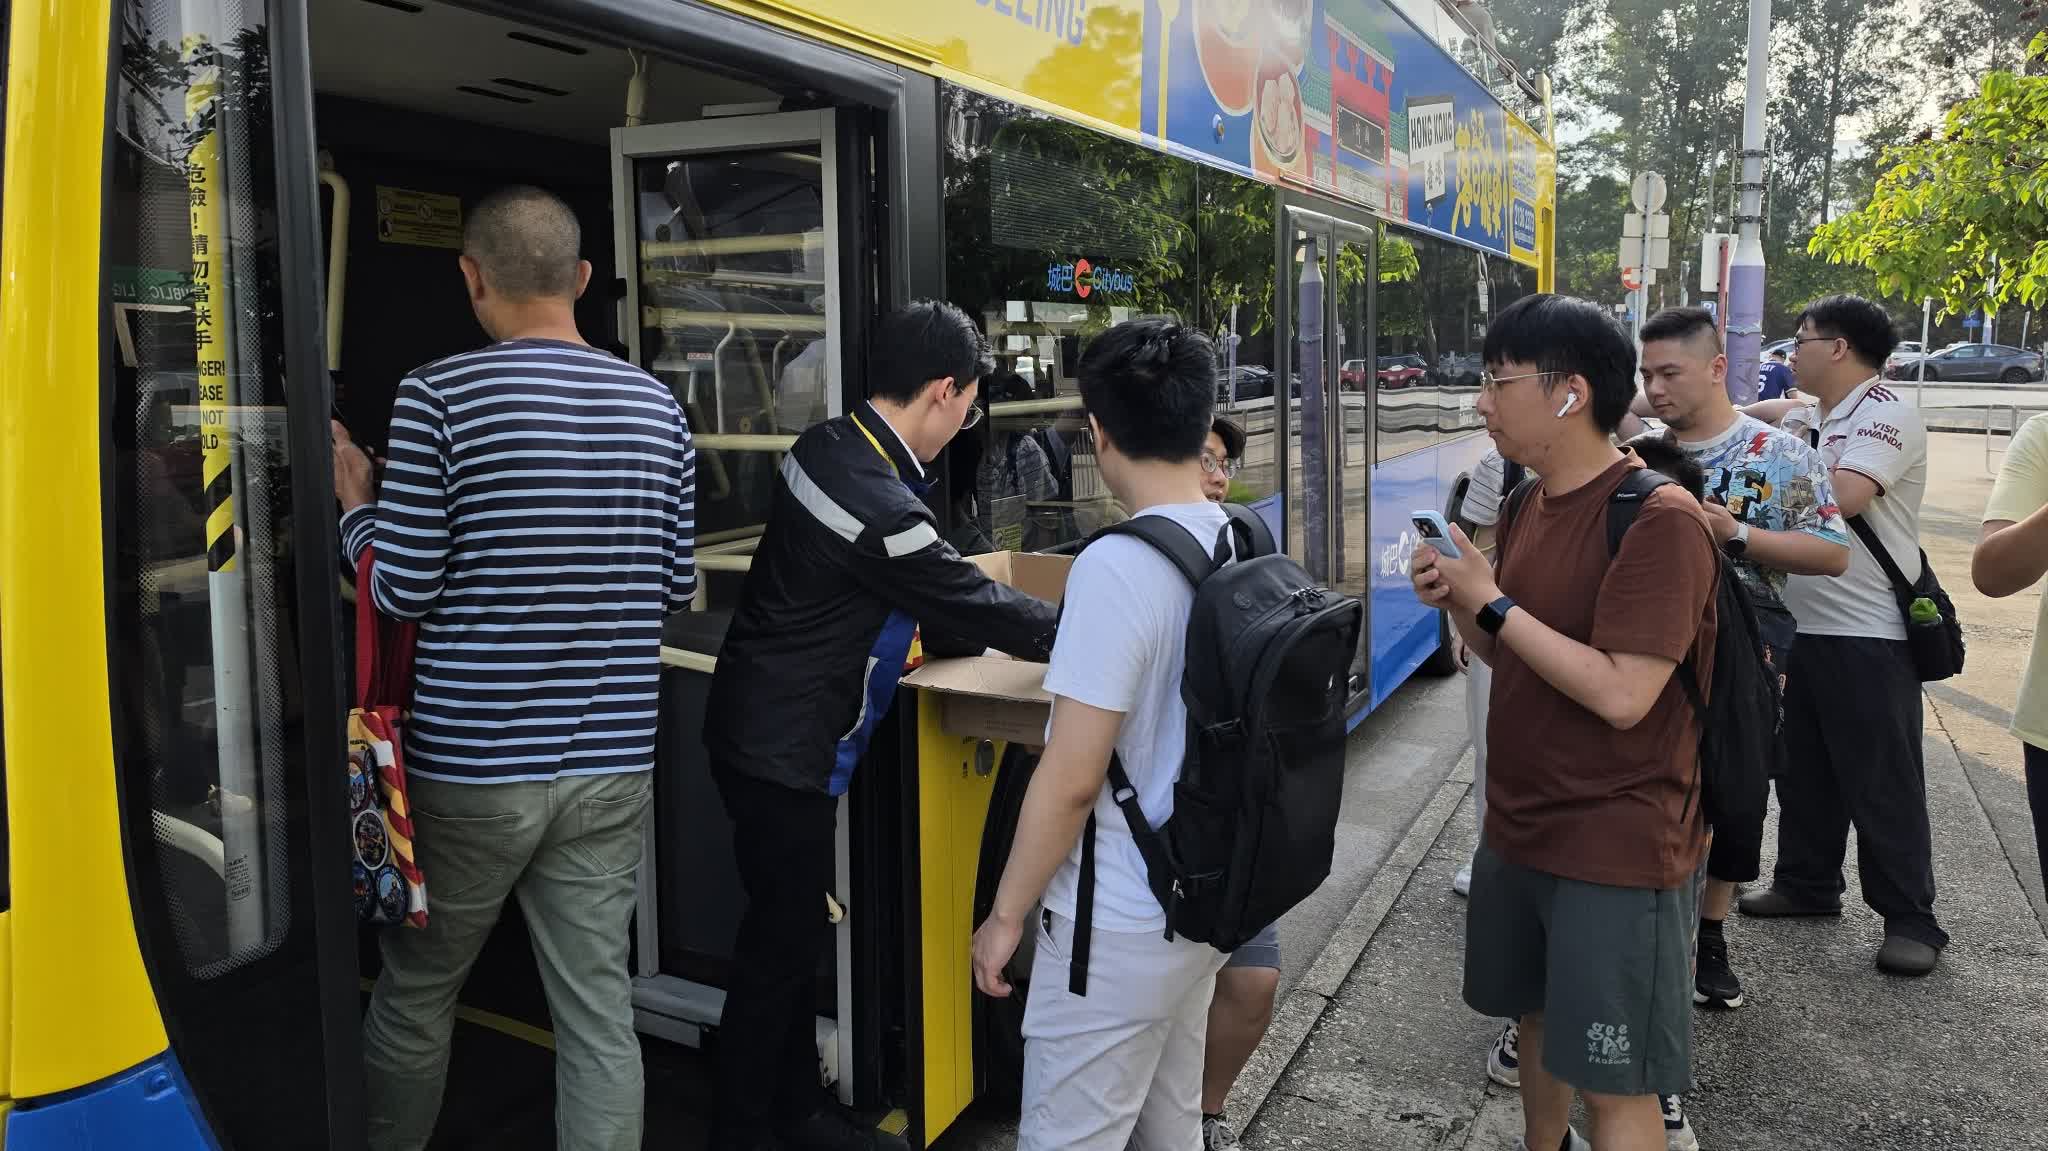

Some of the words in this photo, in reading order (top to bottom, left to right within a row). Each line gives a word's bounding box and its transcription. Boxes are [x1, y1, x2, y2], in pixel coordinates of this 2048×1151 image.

[1410, 116, 1433, 150] HONG
[1434, 111, 1453, 145] KONG
[1093, 266, 1133, 294] Citybus
[1856, 428, 1904, 452] RWANDA
[1873, 421, 1900, 437] VISIT
